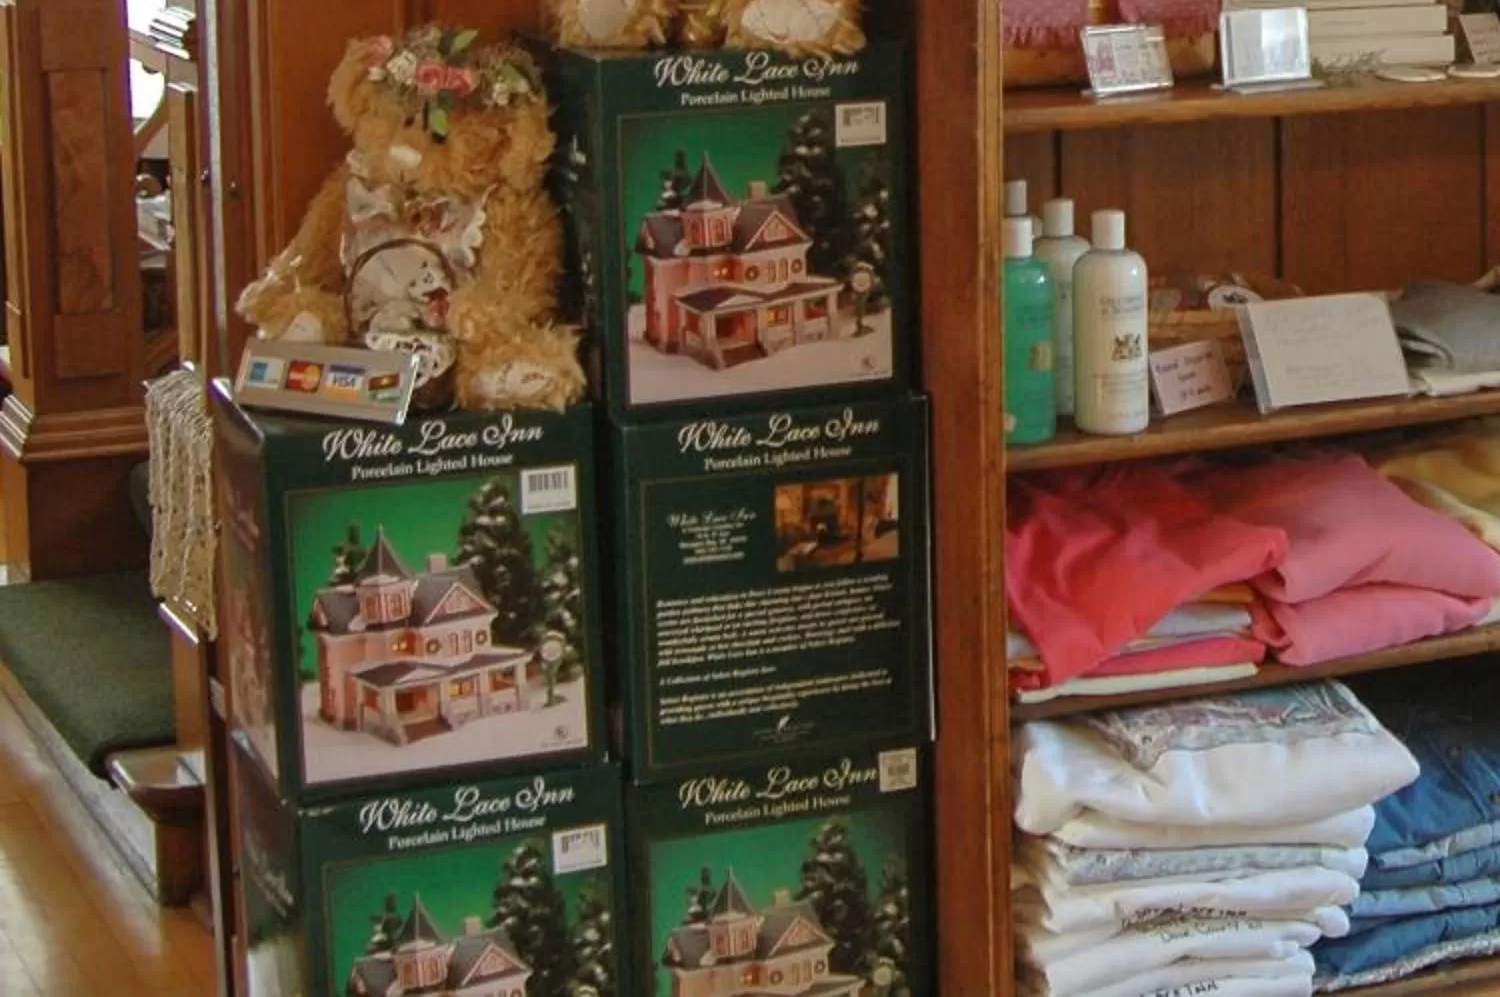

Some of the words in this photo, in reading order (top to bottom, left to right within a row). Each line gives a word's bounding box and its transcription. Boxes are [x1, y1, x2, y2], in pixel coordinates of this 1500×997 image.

[654, 55, 729, 87] White
[733, 51, 798, 85] Lace
[803, 54, 859, 82] Inn
[681, 91, 738, 106] Porcelain
[741, 88, 788, 104] Lighted
[792, 86, 831, 99] House
[322, 427, 402, 462] White
[408, 419, 478, 454] Lace
[482, 413, 544, 449] Inn
[677, 420, 751, 453] White
[756, 412, 820, 447] Lace
[825, 407, 880, 443] Inn
[352, 463, 413, 480] Porcelain
[417, 457, 468, 476] Lighted
[471, 453, 514, 468] House
[704, 454, 761, 471] Porcelain
[764, 450, 810, 466] Lighted
[814, 446, 852, 460] House
[679, 776, 750, 809] White
[756, 766, 819, 799] Lace
[824, 758, 877, 791] Inn
[359, 797, 437, 835] White
[442, 786, 510, 822] Lace
[515, 776, 575, 812] Inn
[705, 808, 761, 825] Porcelain
[763, 802, 810, 818] Lighted
[813, 796, 851, 810] House
[388, 831, 449, 850] Porcelain
[452, 823, 501, 842] Lighted
[504, 816, 547, 832] House
